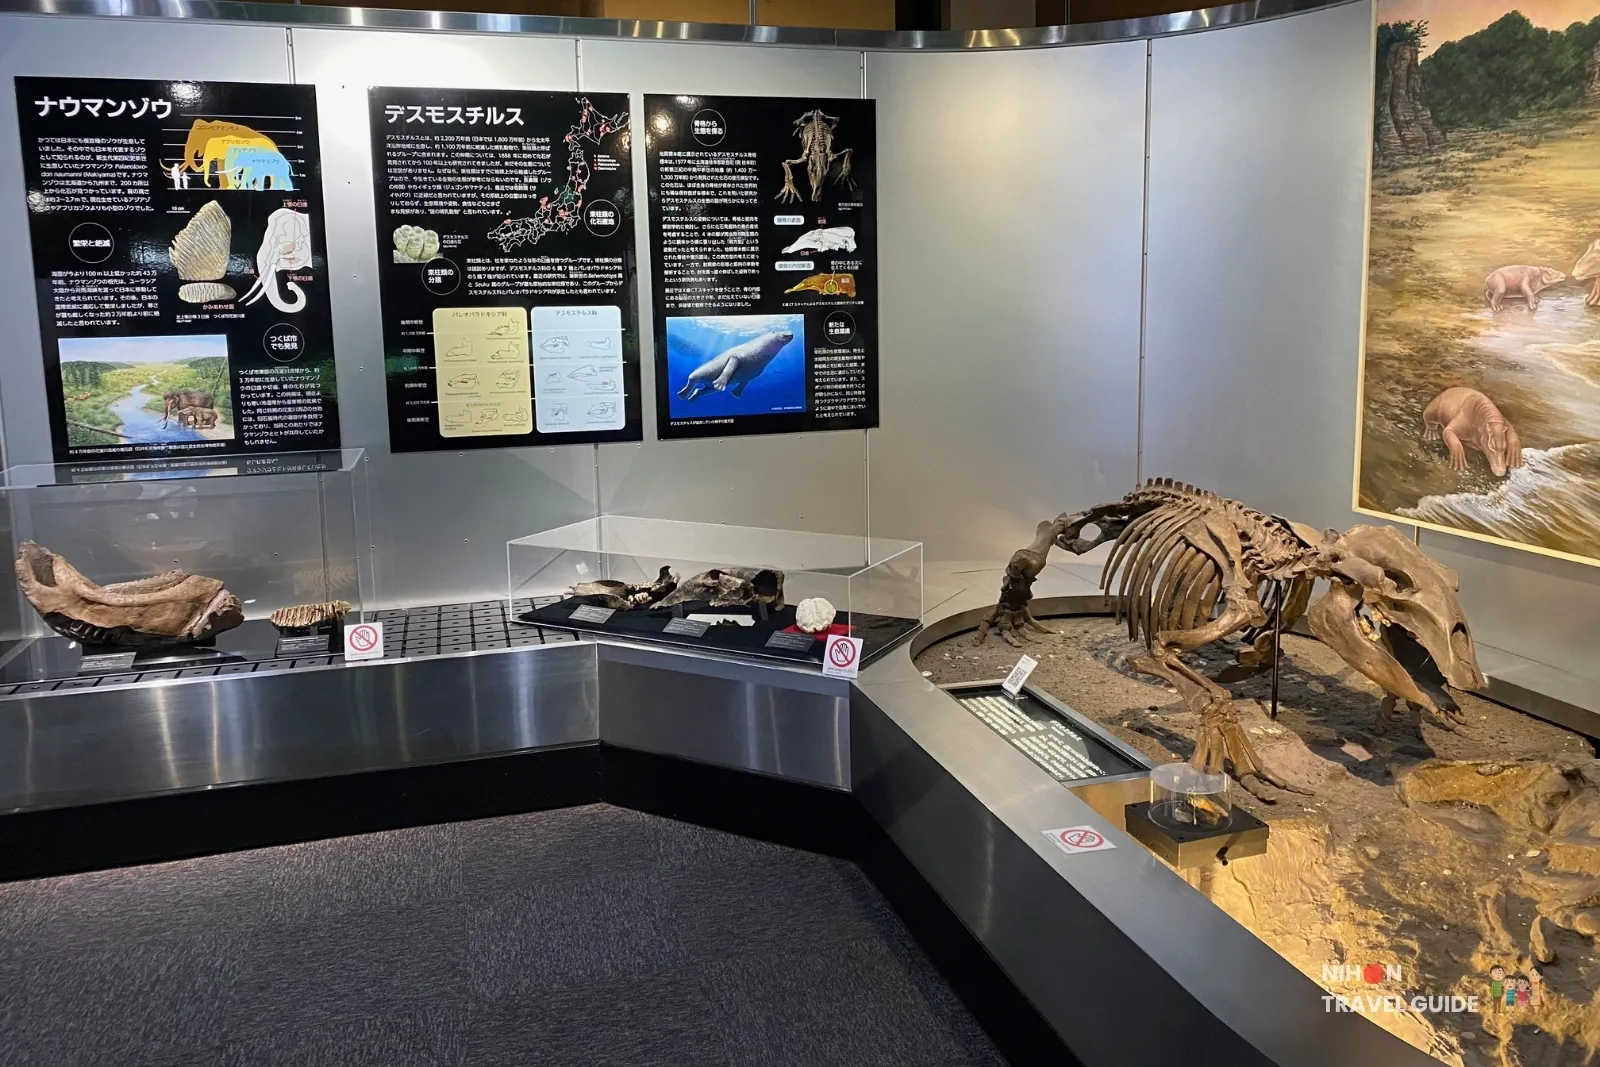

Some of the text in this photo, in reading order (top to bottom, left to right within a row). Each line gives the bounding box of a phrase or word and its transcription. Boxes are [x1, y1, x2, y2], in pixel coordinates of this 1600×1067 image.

[34, 97, 172, 119] ナウマンゾウ
[384, 105, 525, 126] デスモスチルス
[694, 120, 718, 128] 骨格から
[590, 218, 614, 226] 化石産地
[72, 239, 111, 248] 繁栄と絶滅
[428, 276, 442, 284] 分類
